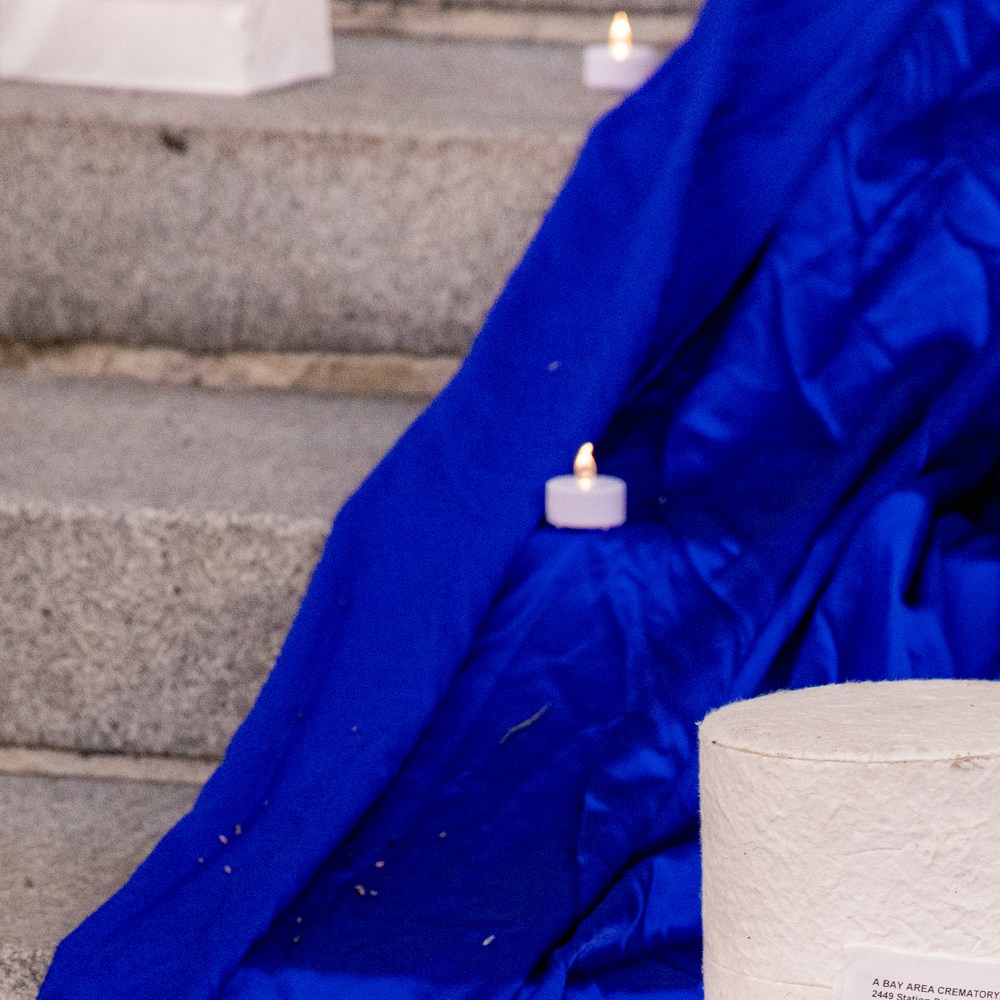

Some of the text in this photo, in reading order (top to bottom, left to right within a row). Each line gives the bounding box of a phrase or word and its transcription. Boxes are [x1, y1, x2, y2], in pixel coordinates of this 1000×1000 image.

[883, 980, 903, 989] BAY
[906, 983, 934, 994] AREA
[872, 990, 893, 1000] 2449
